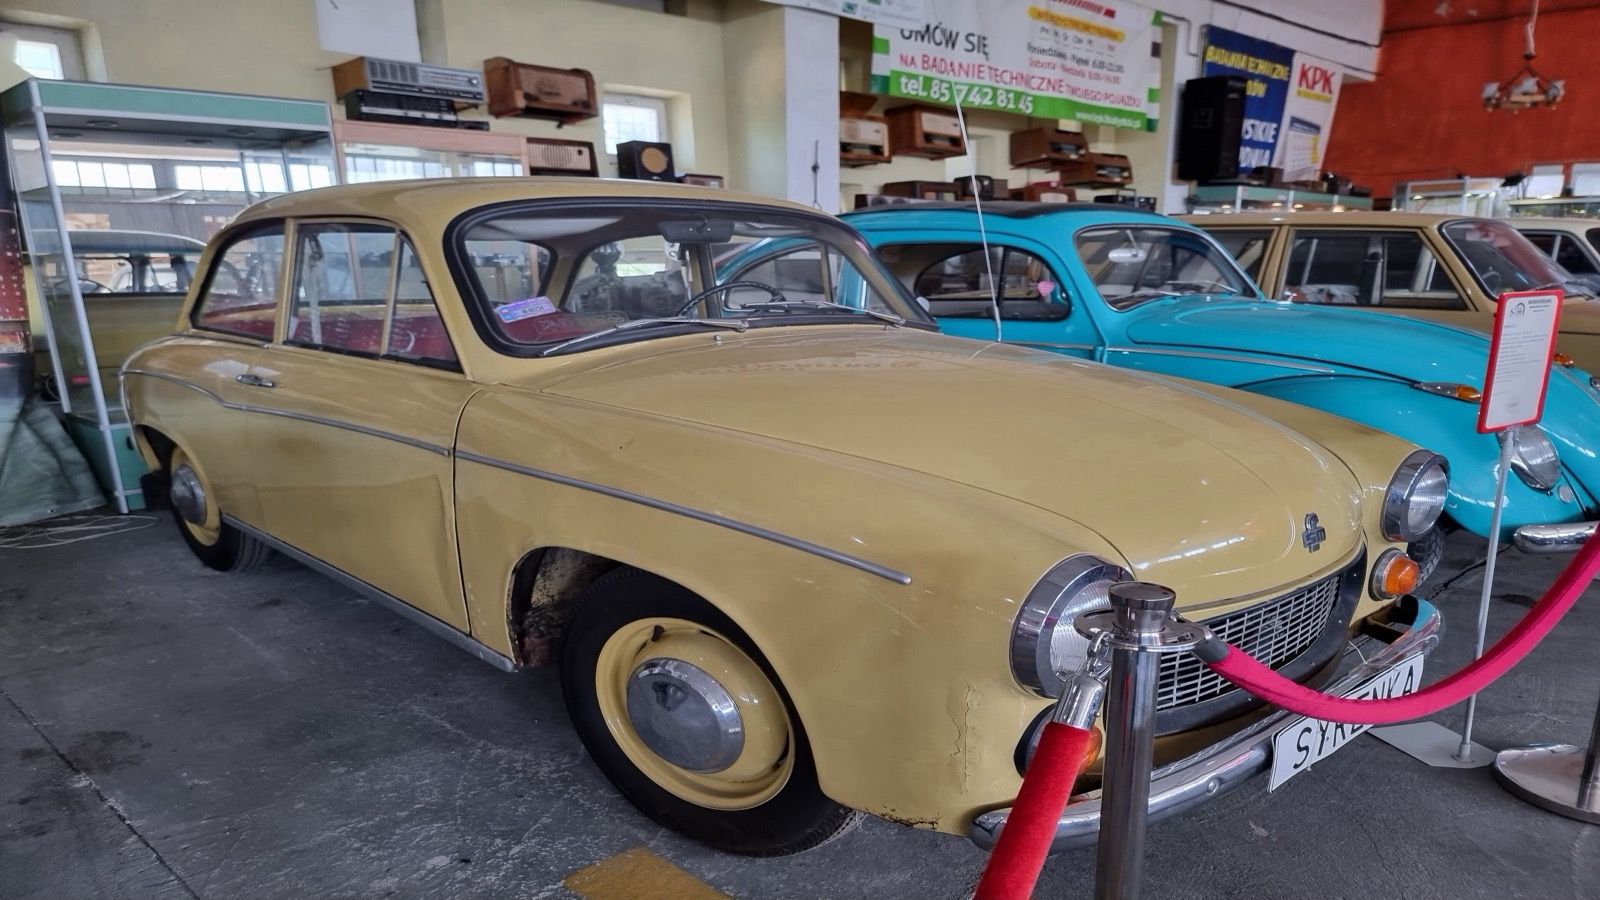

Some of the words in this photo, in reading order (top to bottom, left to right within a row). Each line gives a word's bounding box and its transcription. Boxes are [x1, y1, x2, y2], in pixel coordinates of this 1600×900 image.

[901, 22, 959, 50] UMÓW
[964, 33, 989, 60] SIĘ
[900, 54, 917, 69] NA
[921, 54, 986, 80] BADANIE
[988, 66, 1064, 94] TECHNICZNE
[1298, 63, 1336, 95] KPK
[930, 80, 950, 102] 85
[954, 84, 994, 106] 742
[996, 90, 1016, 109] 81
[1018, 94, 1034, 113] 45
